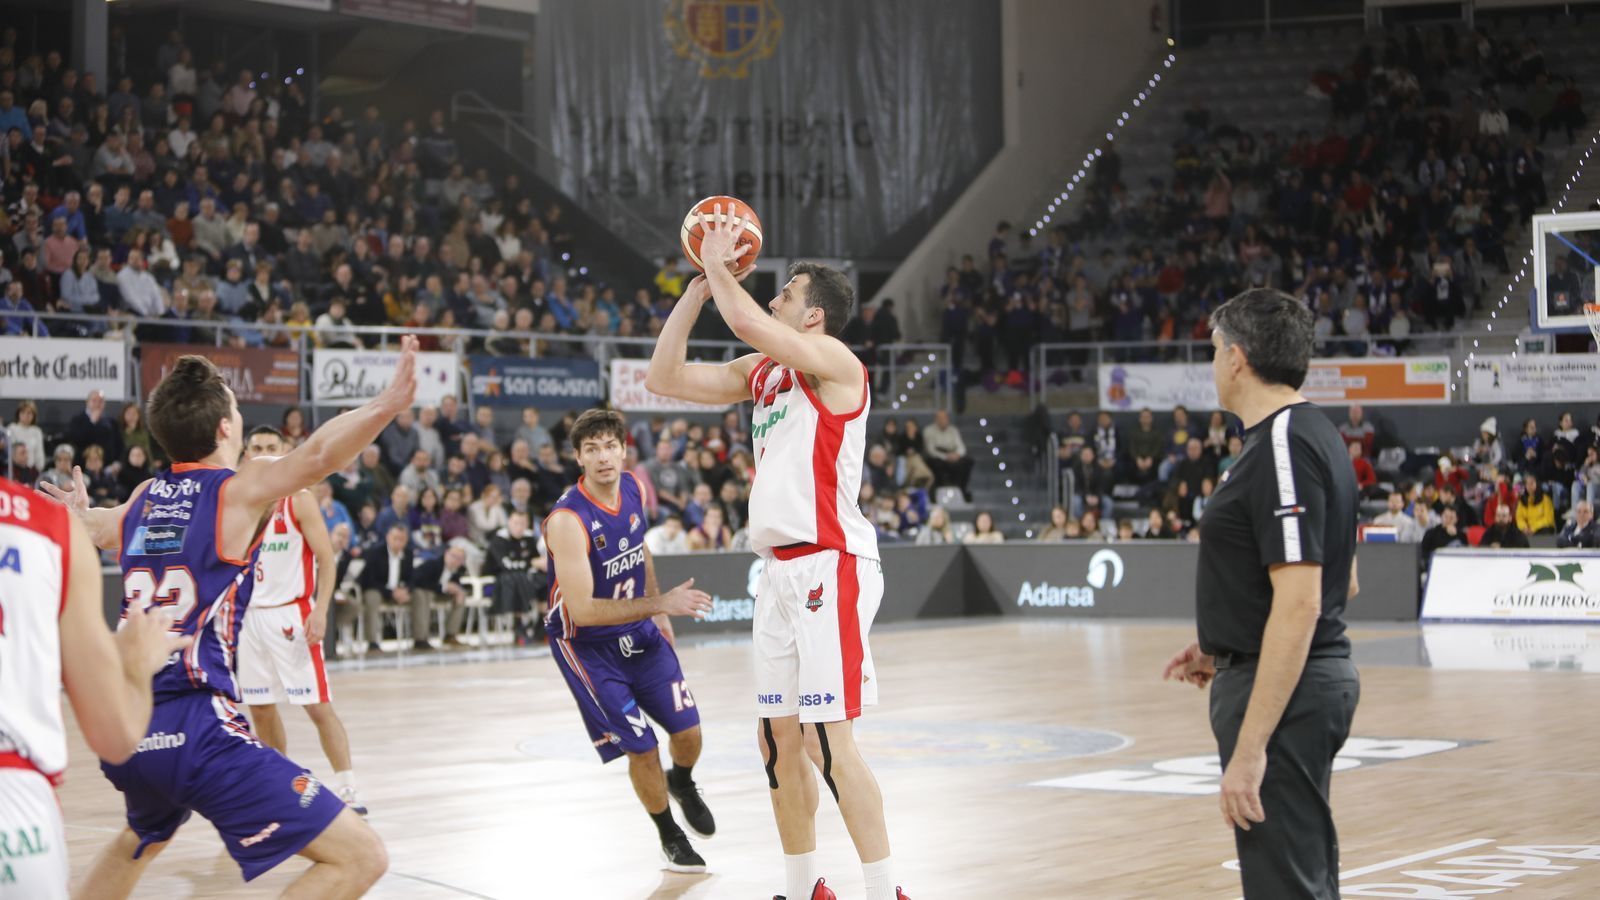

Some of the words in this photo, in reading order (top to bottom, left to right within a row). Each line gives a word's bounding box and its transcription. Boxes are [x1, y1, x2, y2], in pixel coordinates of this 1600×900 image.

[32, 355, 50, 379] de
[52, 354, 118, 380] Castilla
[602, 543, 646, 580] TRAPA
[1017, 580, 1095, 607] Adarsa
[1493, 594, 1600, 608] GAHERPROG
[704, 595, 754, 622] darsa
[671, 680, 696, 713] 13
[1337, 838, 1600, 900] RAPA
